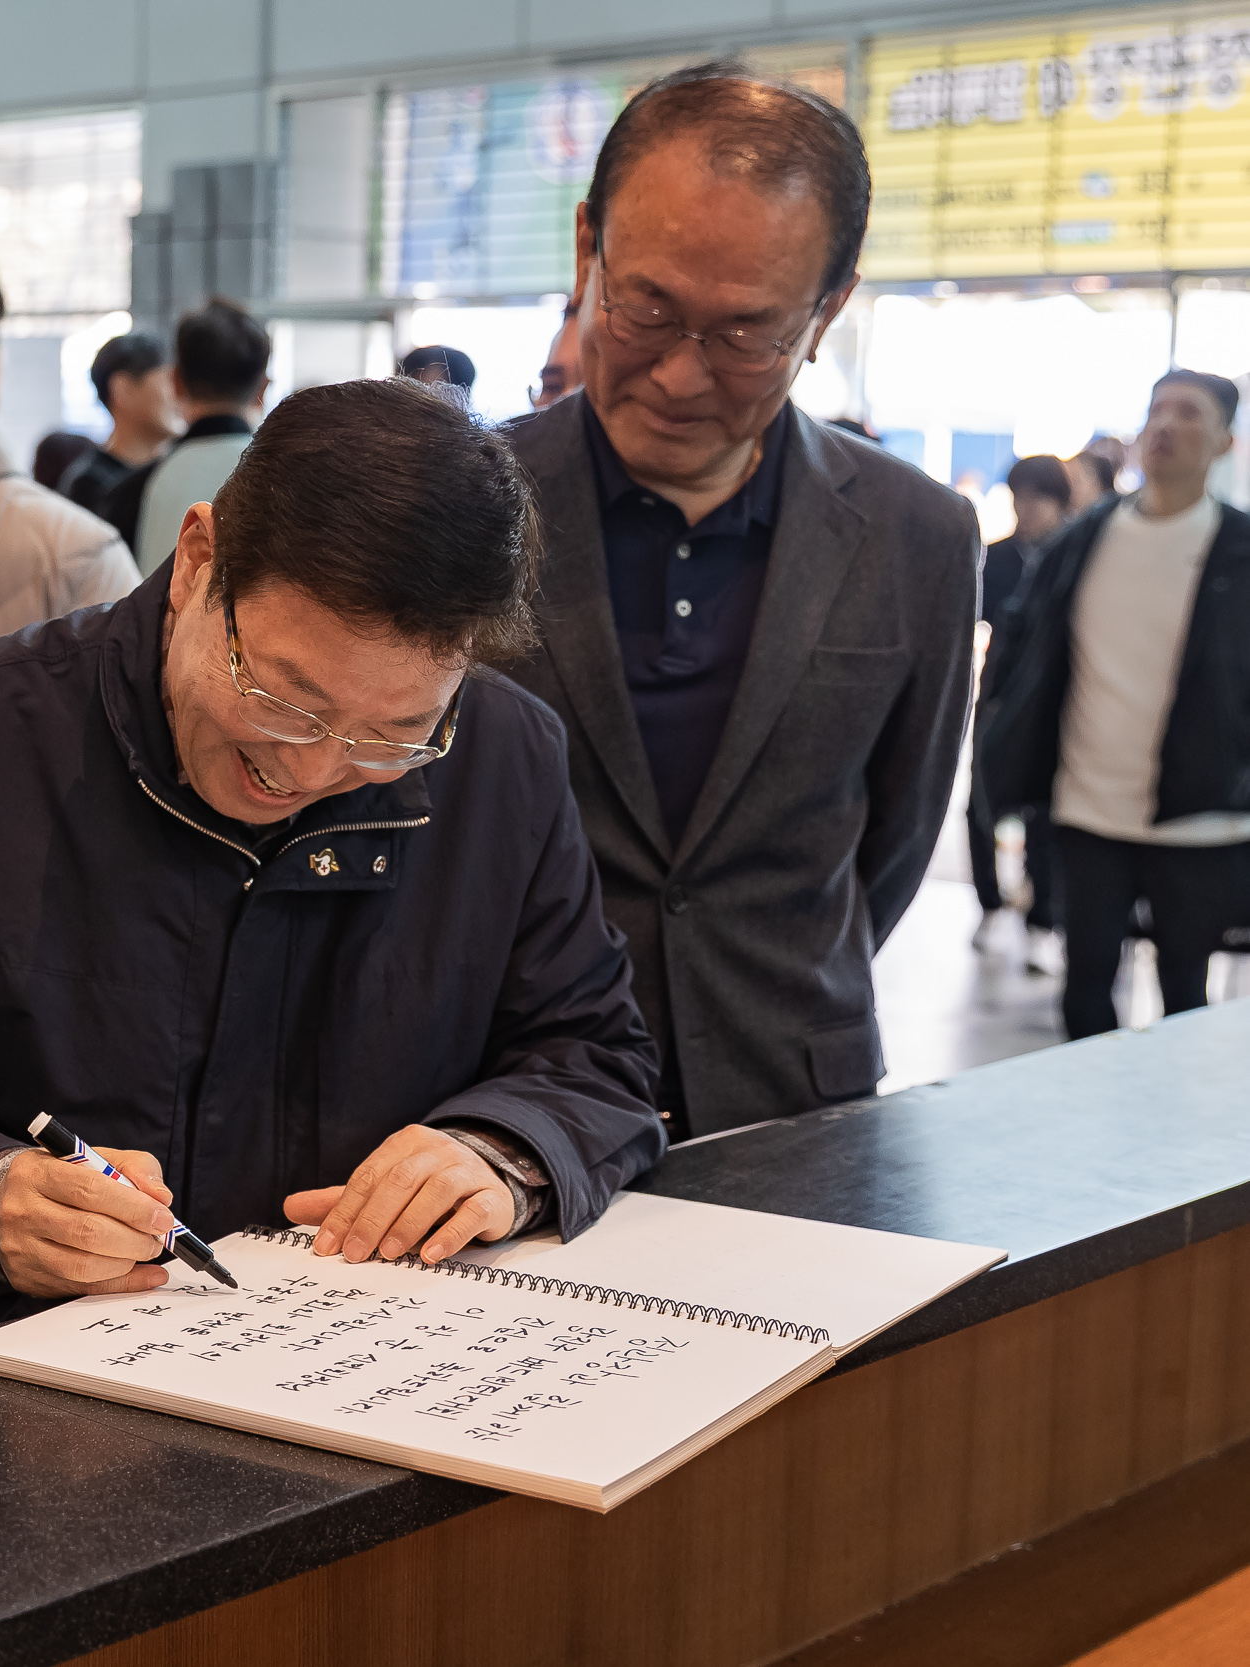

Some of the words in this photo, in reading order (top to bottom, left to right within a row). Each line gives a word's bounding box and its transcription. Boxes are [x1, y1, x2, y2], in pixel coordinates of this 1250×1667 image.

[245, 1275, 320, 1305] 무궁한
[179, 1311, 255, 1336] 발전을
[466, 1316, 556, 1353] 진심으로
[544, 1325, 618, 1352] 광진구
[559, 1336, 690, 1386] 정관장과
[491, 1393, 583, 1420] 함께
[464, 1422, 522, 1442] 하는
